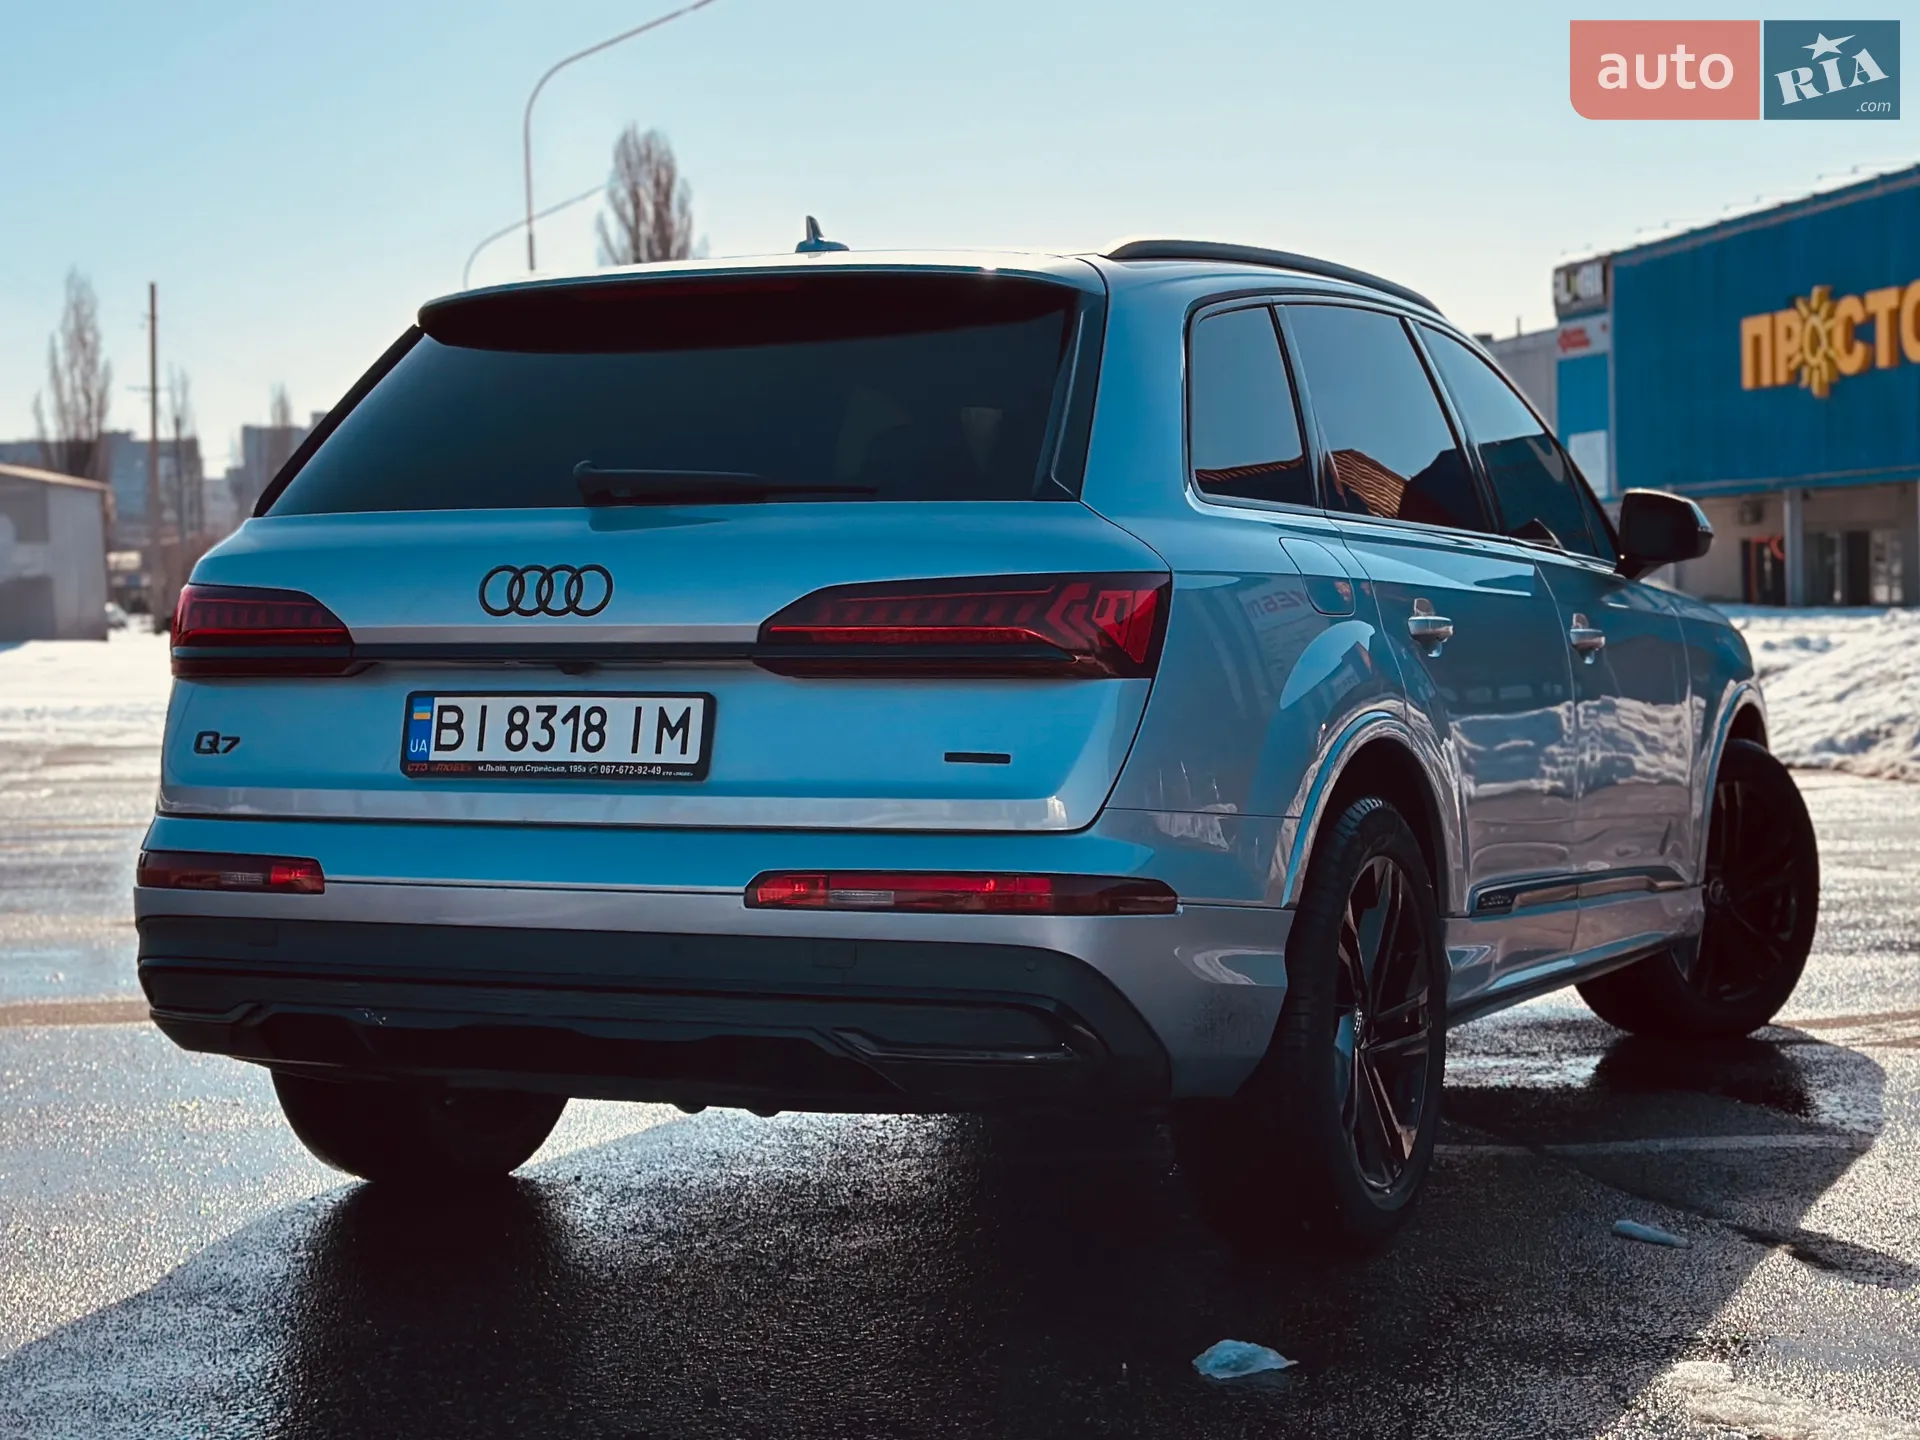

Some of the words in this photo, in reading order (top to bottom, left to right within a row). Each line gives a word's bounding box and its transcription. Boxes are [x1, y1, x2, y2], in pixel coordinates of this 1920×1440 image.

[433, 704, 488, 752] BI
[504, 705, 608, 753] 8318
[631, 706, 692, 755] IM
[193, 730, 241, 754] Q7
[409, 739, 428, 753] UA
[600, 764, 662, 775] 067-672-92-49
